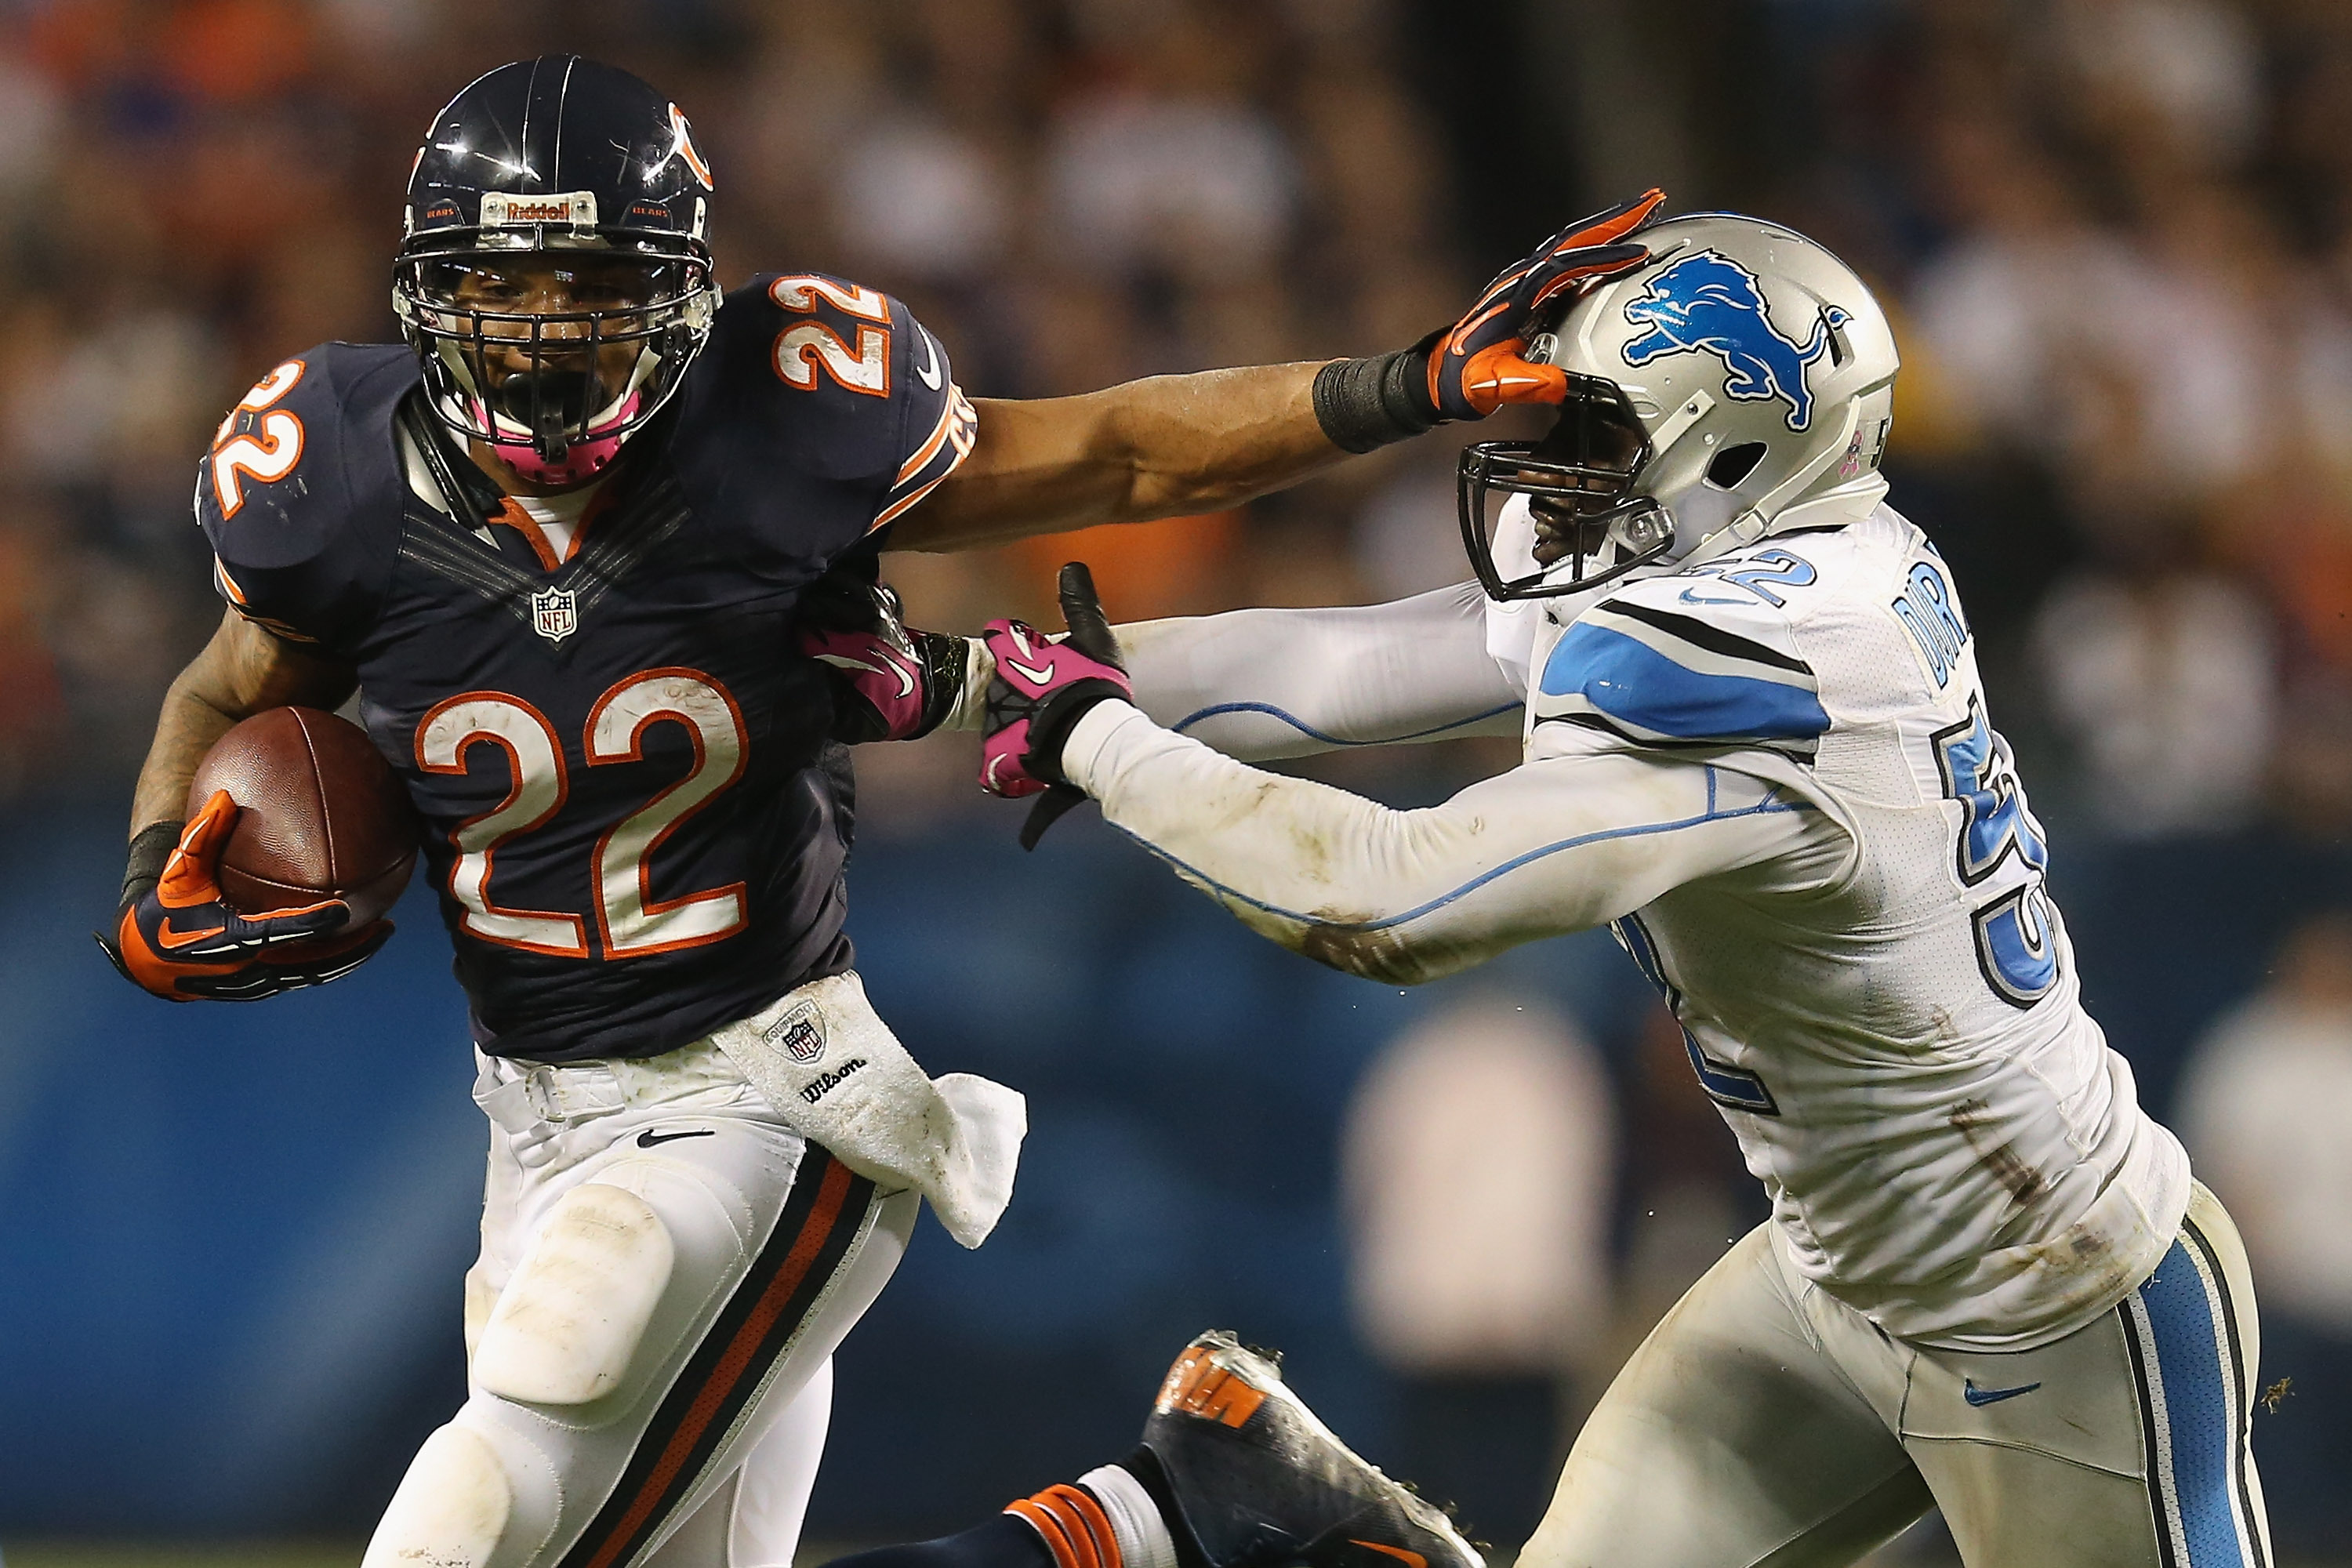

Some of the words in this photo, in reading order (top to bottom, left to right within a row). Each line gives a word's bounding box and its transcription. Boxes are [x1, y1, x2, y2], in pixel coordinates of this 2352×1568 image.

[426, 208, 456, 219] BEARS
[507, 202, 570, 220] Riddell
[632, 206, 668, 218] BEARS
[768, 274, 891, 399] 22
[212, 360, 307, 521] 22
[541, 611, 572, 632] NFL
[414, 666, 750, 961] 22
[791, 1032, 820, 1058] NFL
[800, 1058, 868, 1104] Wilson
